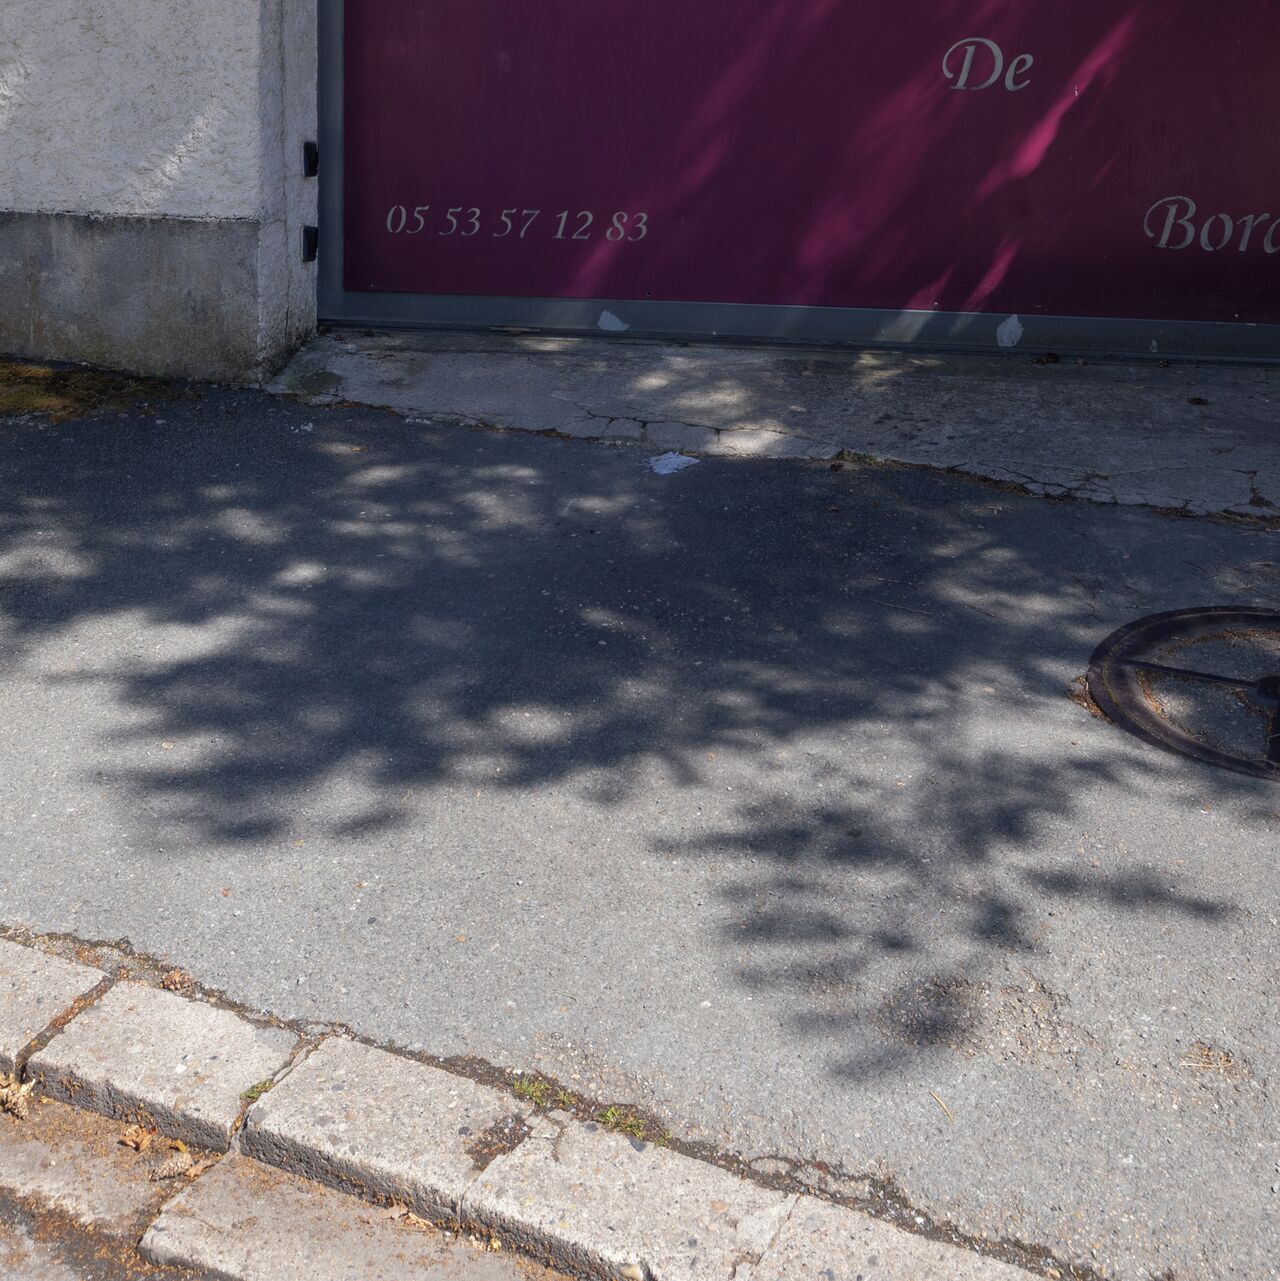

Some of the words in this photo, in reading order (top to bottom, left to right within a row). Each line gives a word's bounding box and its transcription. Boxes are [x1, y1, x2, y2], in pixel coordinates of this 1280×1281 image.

[942, 36, 1034, 92] De
[385, 204, 431, 235] 05
[438, 206, 482, 237] 53
[493, 208, 541, 239] 57
[551, 210, 595, 241] 12
[605, 211, 649, 242] 83
